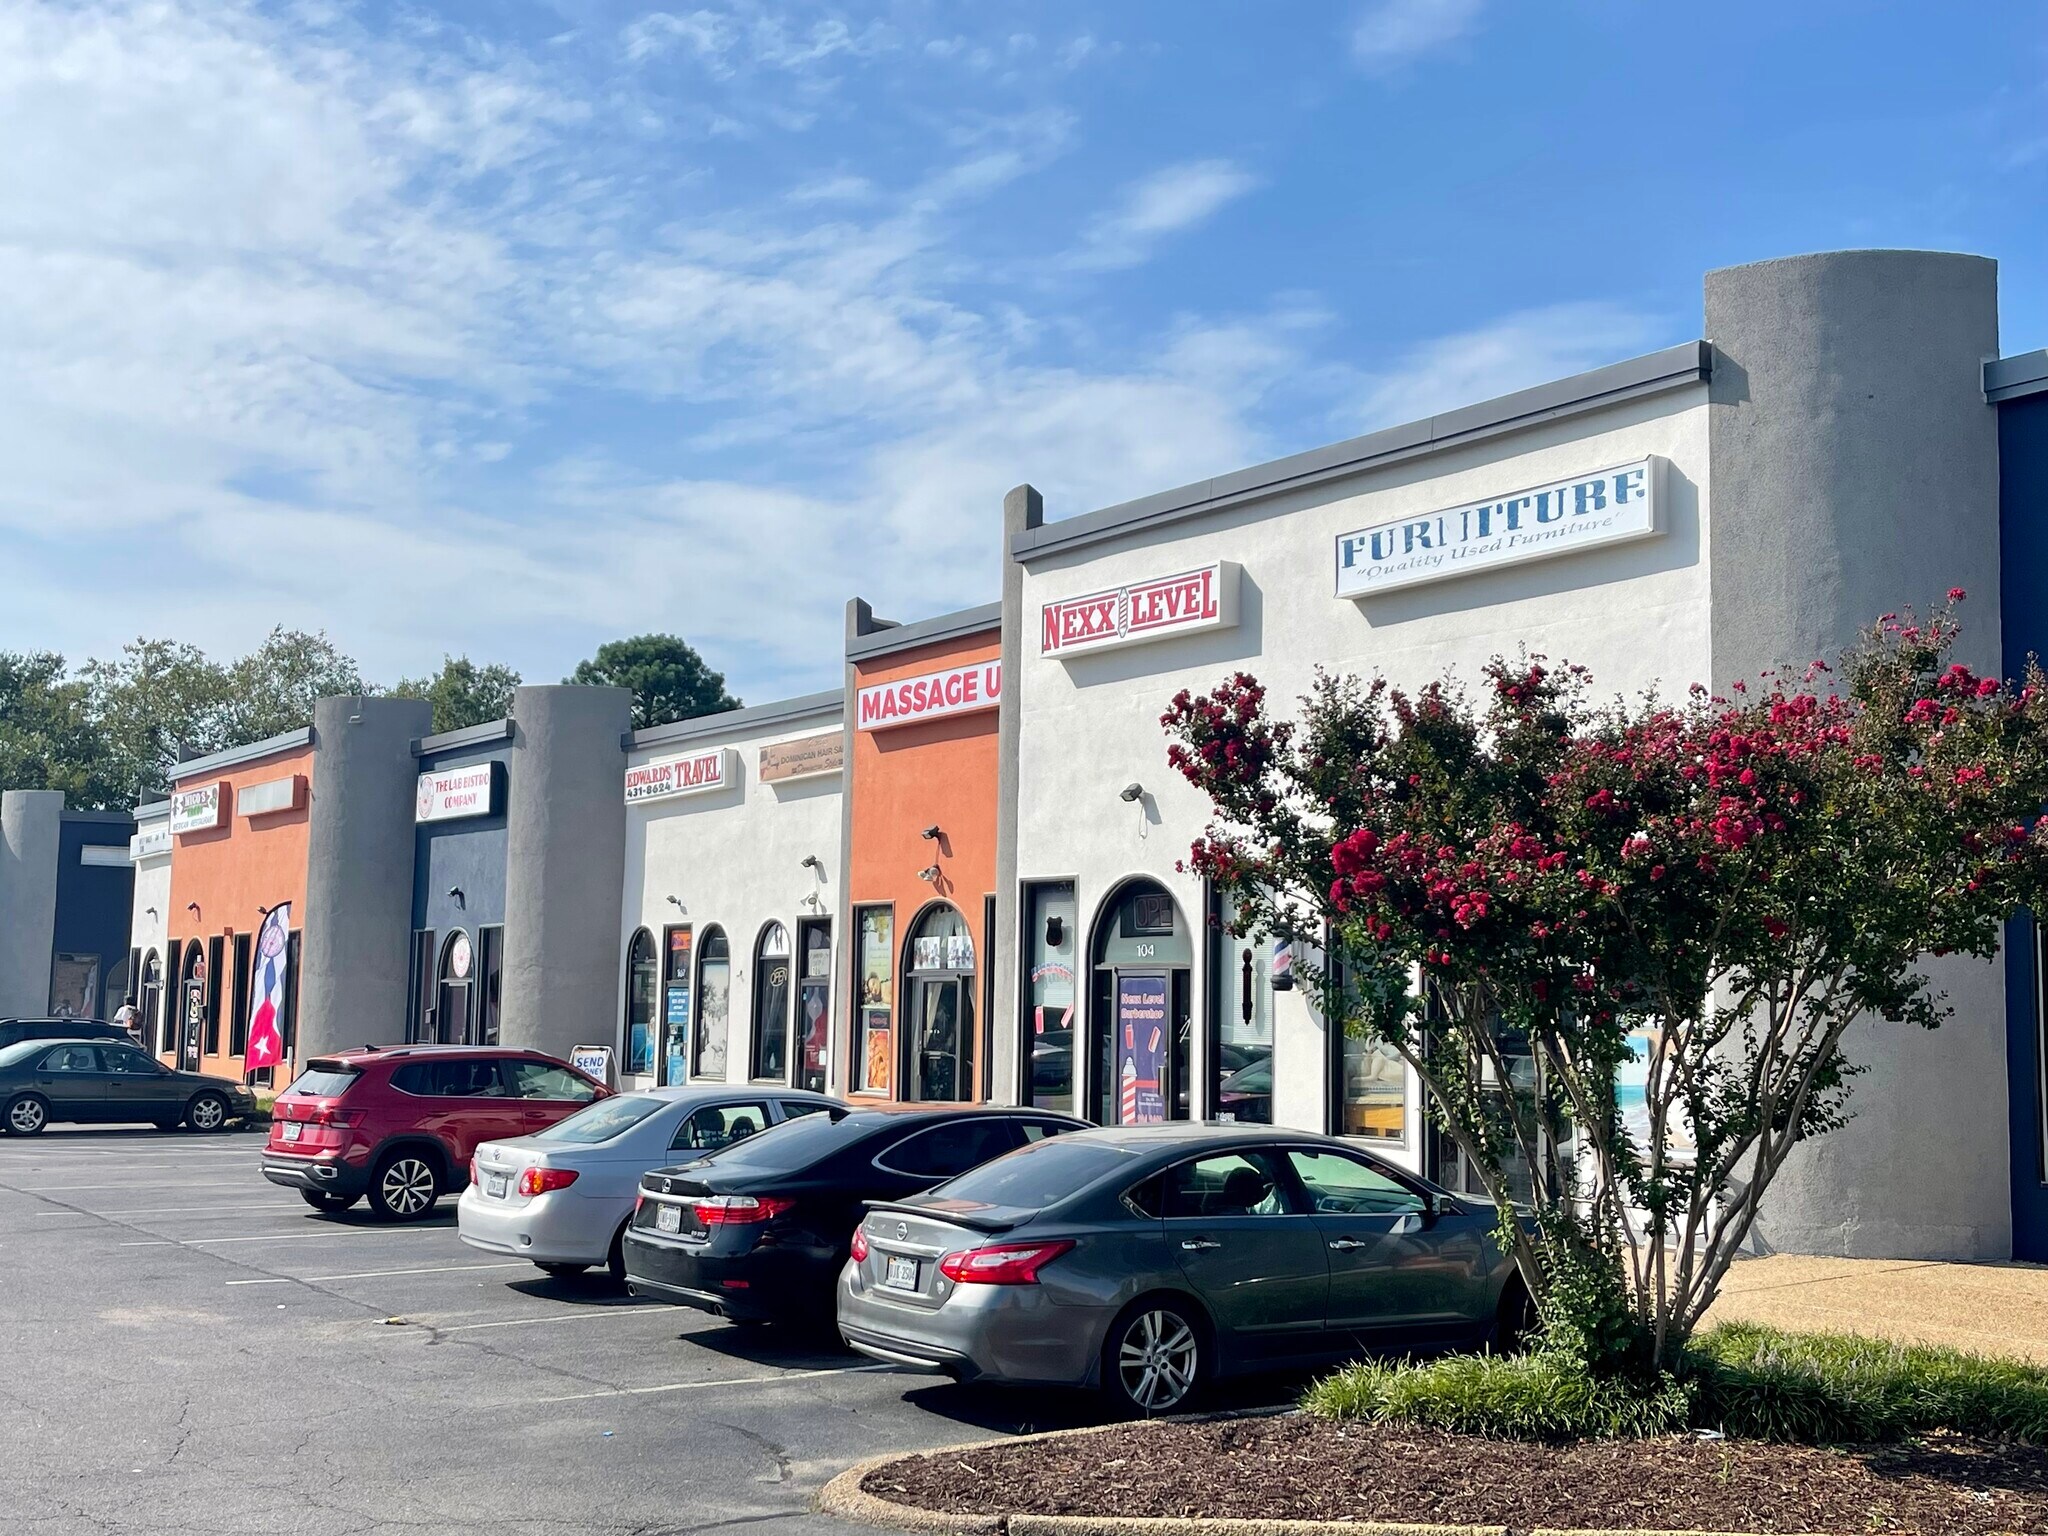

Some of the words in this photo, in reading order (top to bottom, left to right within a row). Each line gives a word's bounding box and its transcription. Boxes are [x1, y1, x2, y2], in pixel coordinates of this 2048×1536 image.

[1450, 537, 1502, 560] Used
[1043, 605, 1116, 651] NEXX
[1130, 570, 1217, 625] LEVEL
[862, 670, 978, 723] MASSAGE
[817, 747, 833, 758] HAIR
[674, 754, 720, 788] TRAVEL
[435, 780, 448, 793] THE
[448, 777, 463, 791] LAB
[463, 773, 489, 788] BISTRO
[626, 781, 671, 798] 431-8624
[444, 793, 477, 809] COMPANY
[1136, 944, 1154, 957] 104
[1121, 992, 1141, 1005] Nexx
[1142, 992, 1165, 1005] Level
[1121, 1007, 1164, 1019] Barbershop
[576, 1056, 604, 1067] SEND
[583, 1067, 602, 1076] ONEY
